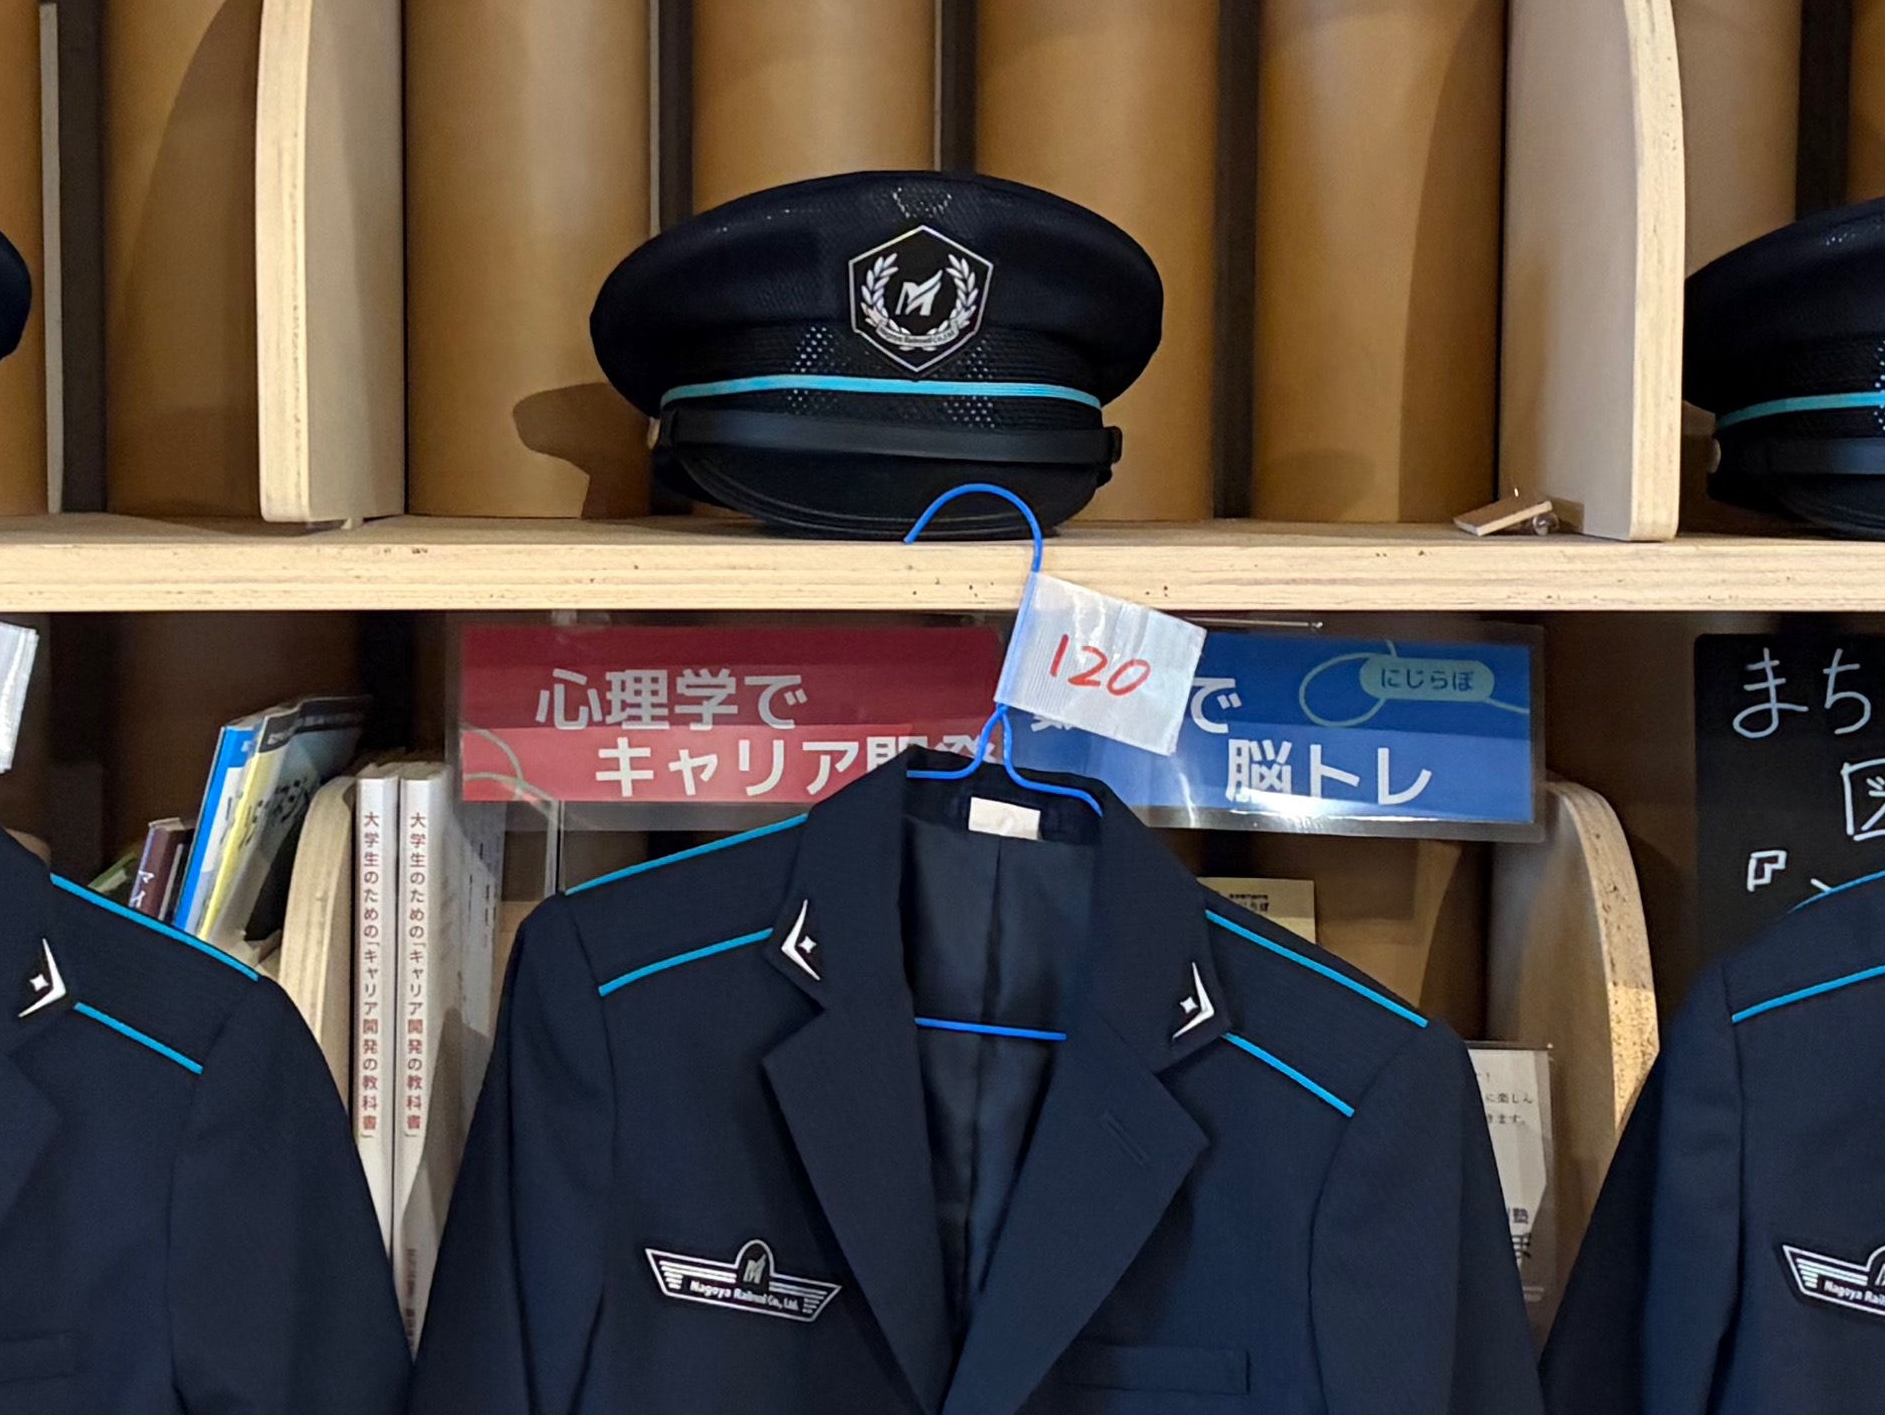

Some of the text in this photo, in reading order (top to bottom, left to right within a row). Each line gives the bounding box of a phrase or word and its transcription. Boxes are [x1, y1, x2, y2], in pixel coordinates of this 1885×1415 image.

[1047, 633, 1152, 698] 120
[1379, 665, 1477, 696] にじらぼ
[536, 666, 809, 732] 心理学で
[1224, 740, 1432, 805] 脳トレ
[690, 1280, 732, 1299] Nagoya
[1823, 1279, 1864, 1301] Nagoya
